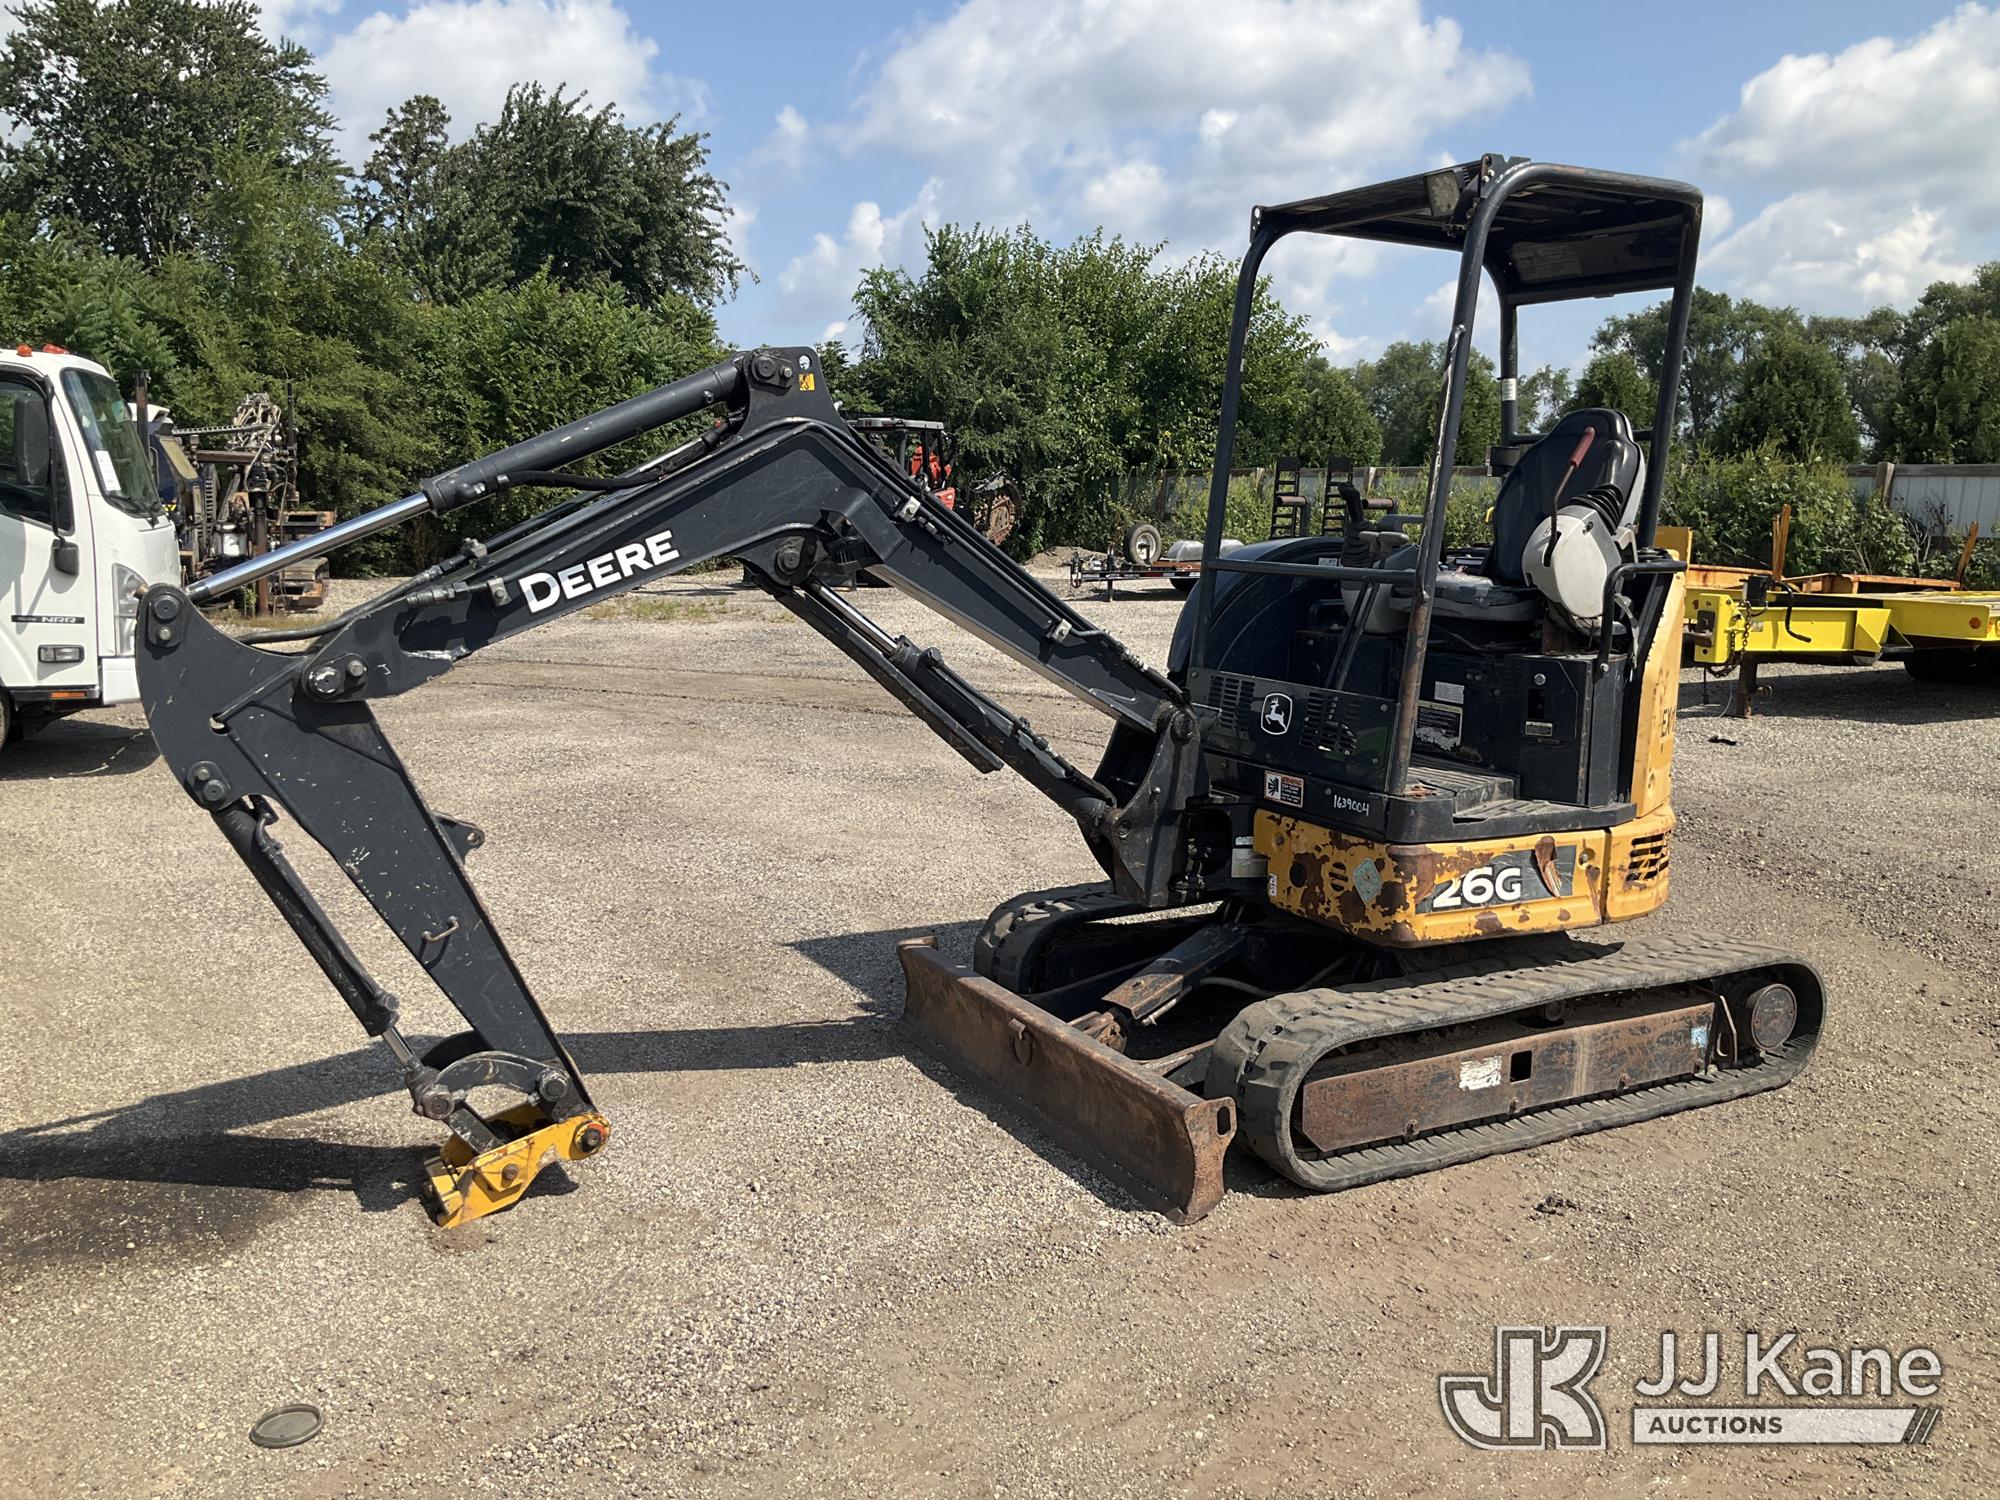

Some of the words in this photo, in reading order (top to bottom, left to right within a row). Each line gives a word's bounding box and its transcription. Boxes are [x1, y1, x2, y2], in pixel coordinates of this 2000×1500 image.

[518, 530, 680, 614] DEERE
[41, 616, 77, 624] NRR
[1333, 794, 1370, 817] 1639004
[1433, 866, 1521, 908] 26G
